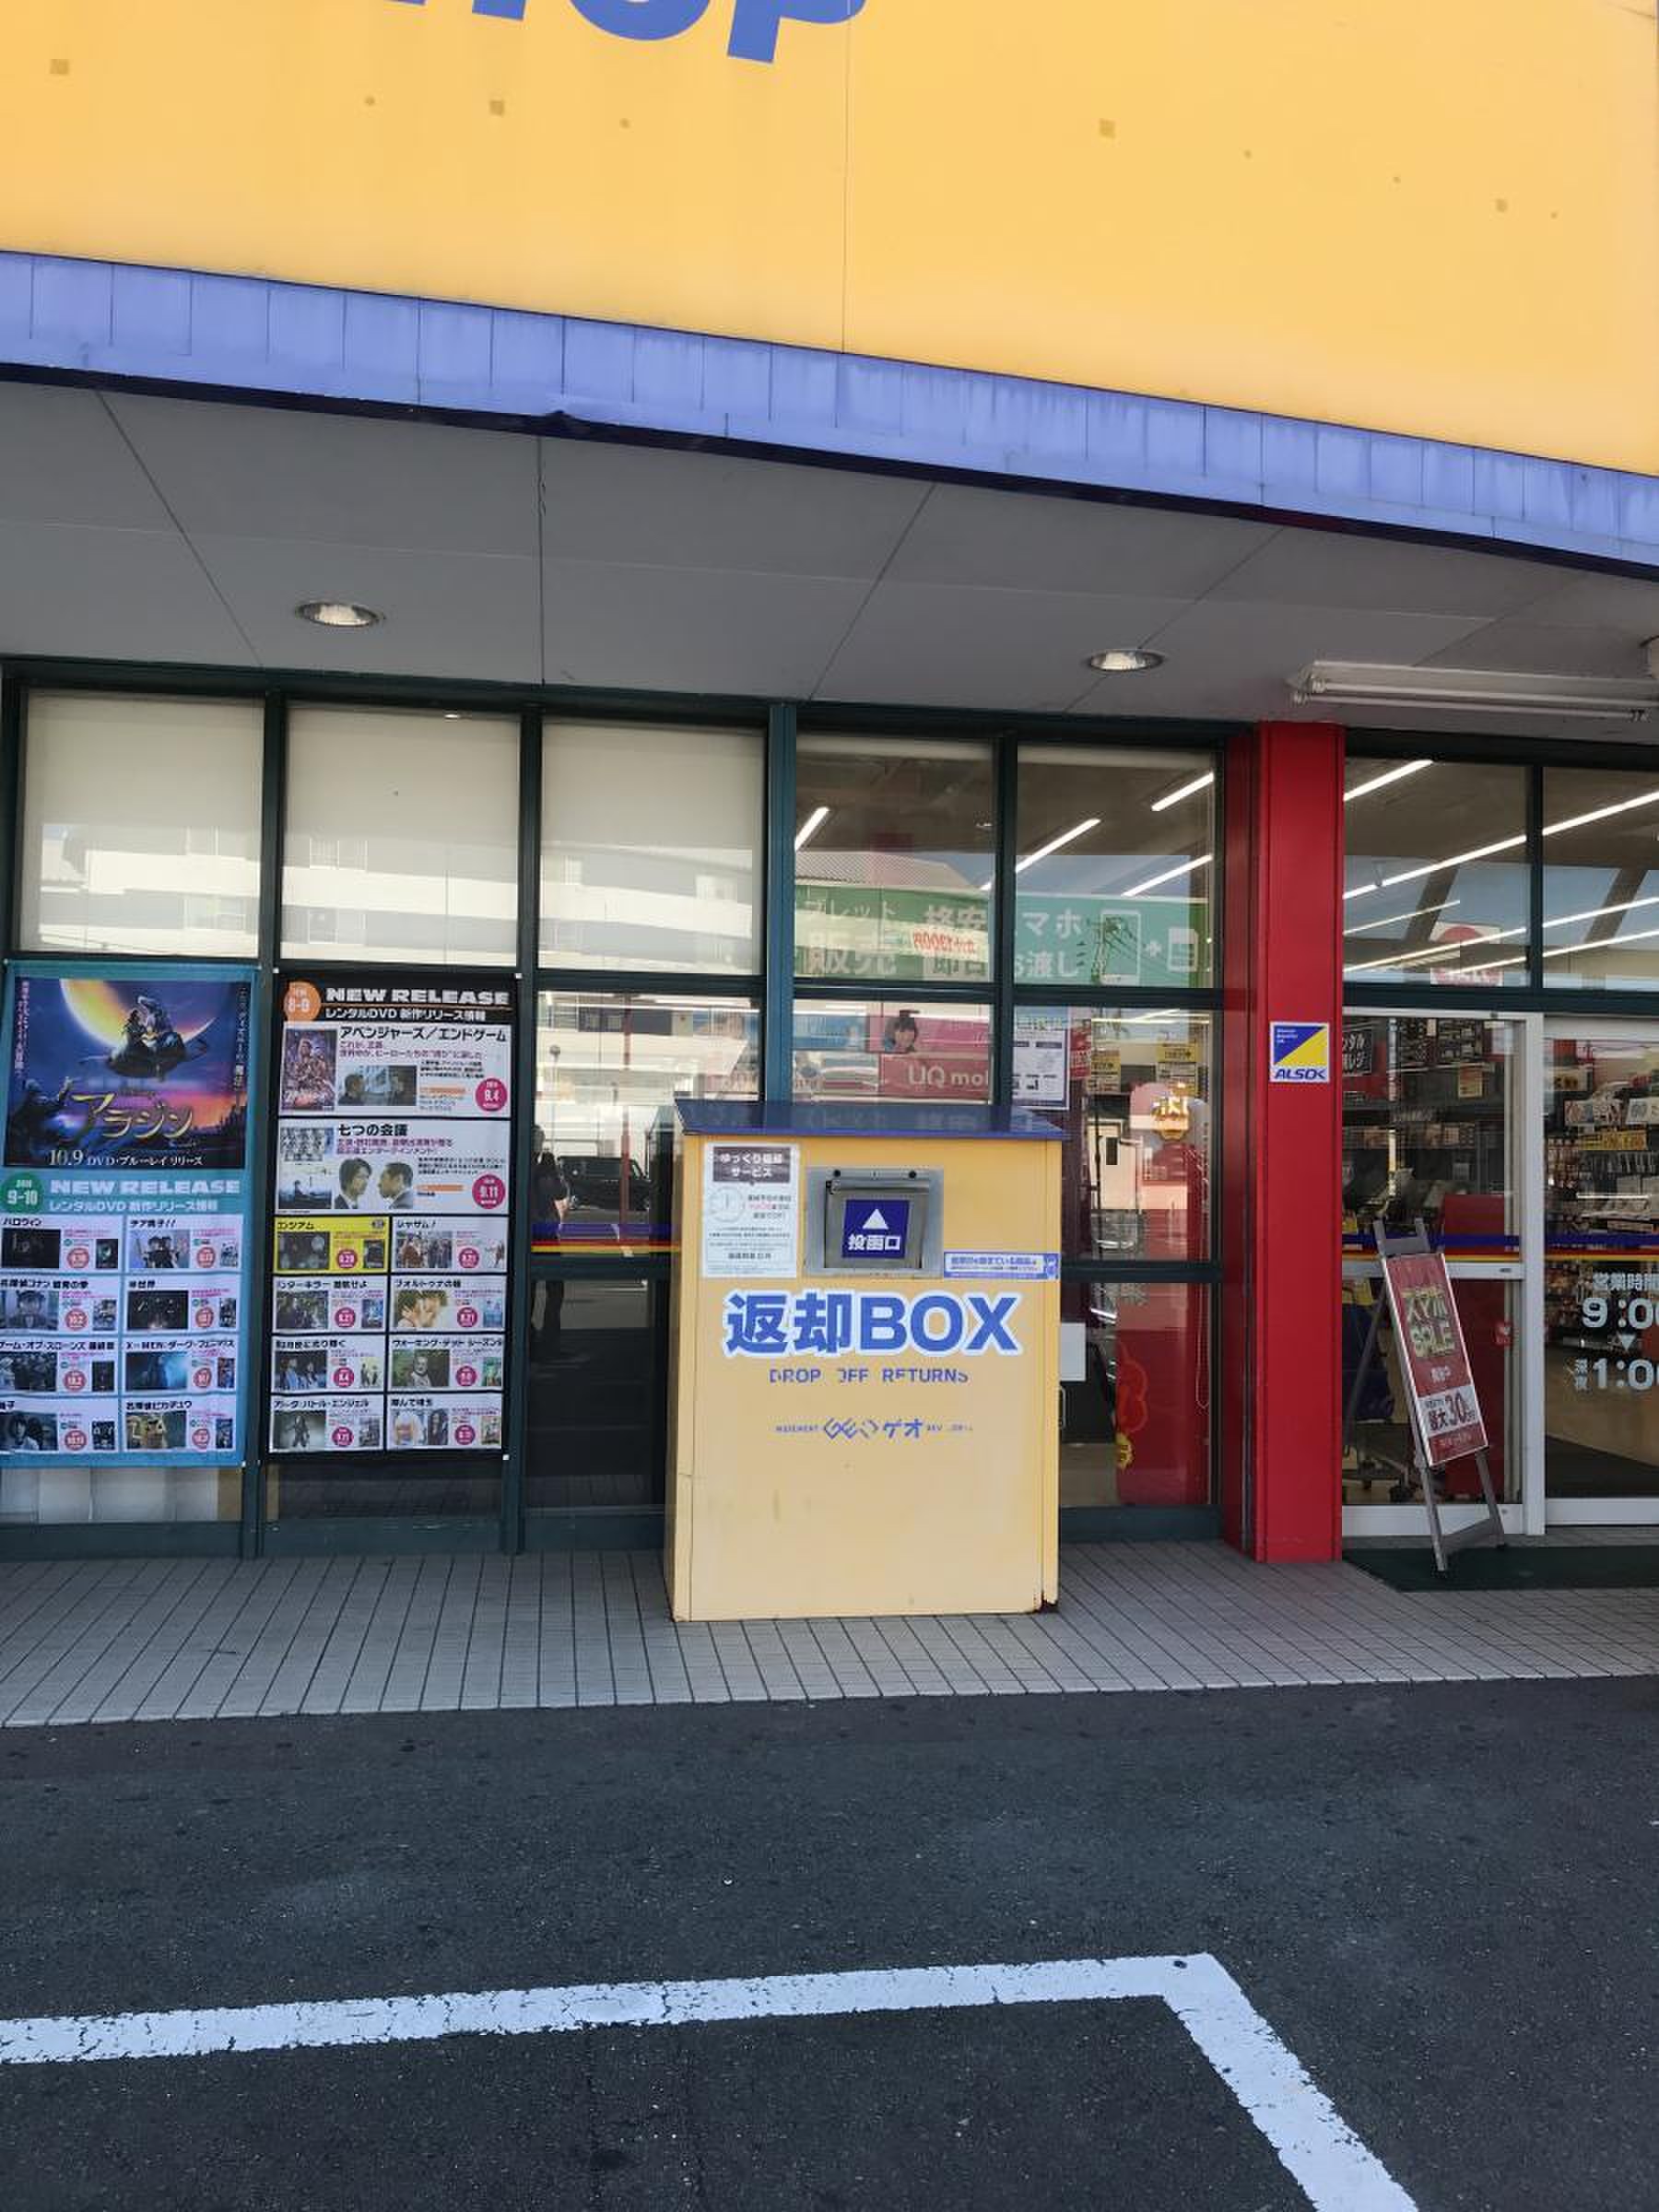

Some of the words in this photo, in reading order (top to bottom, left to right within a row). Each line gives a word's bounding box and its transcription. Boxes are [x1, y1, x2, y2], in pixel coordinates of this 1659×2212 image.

[325, 988, 391, 1003] NEW
[392, 989, 510, 1005] RELEASE
[908, 1065, 945, 1088] UQ
[1274, 1068, 1326, 1080] ALSOK
[71, 1093, 193, 1138] アラジン
[49, 1149, 84, 1166] 10.9
[50, 1180, 118, 1194] NEW
[121, 1180, 241, 1194] RELEASE
[848, 1234, 900, 1251] 投函口
[1582, 1297, 1659, 1329] 9:0
[724, 1291, 1020, 1355] 返却BOX
[769, 1368, 821, 1383] DROP
[1593, 1358, 1659, 1391] 1:0
[883, 1418, 924, 1440] ゲオ
